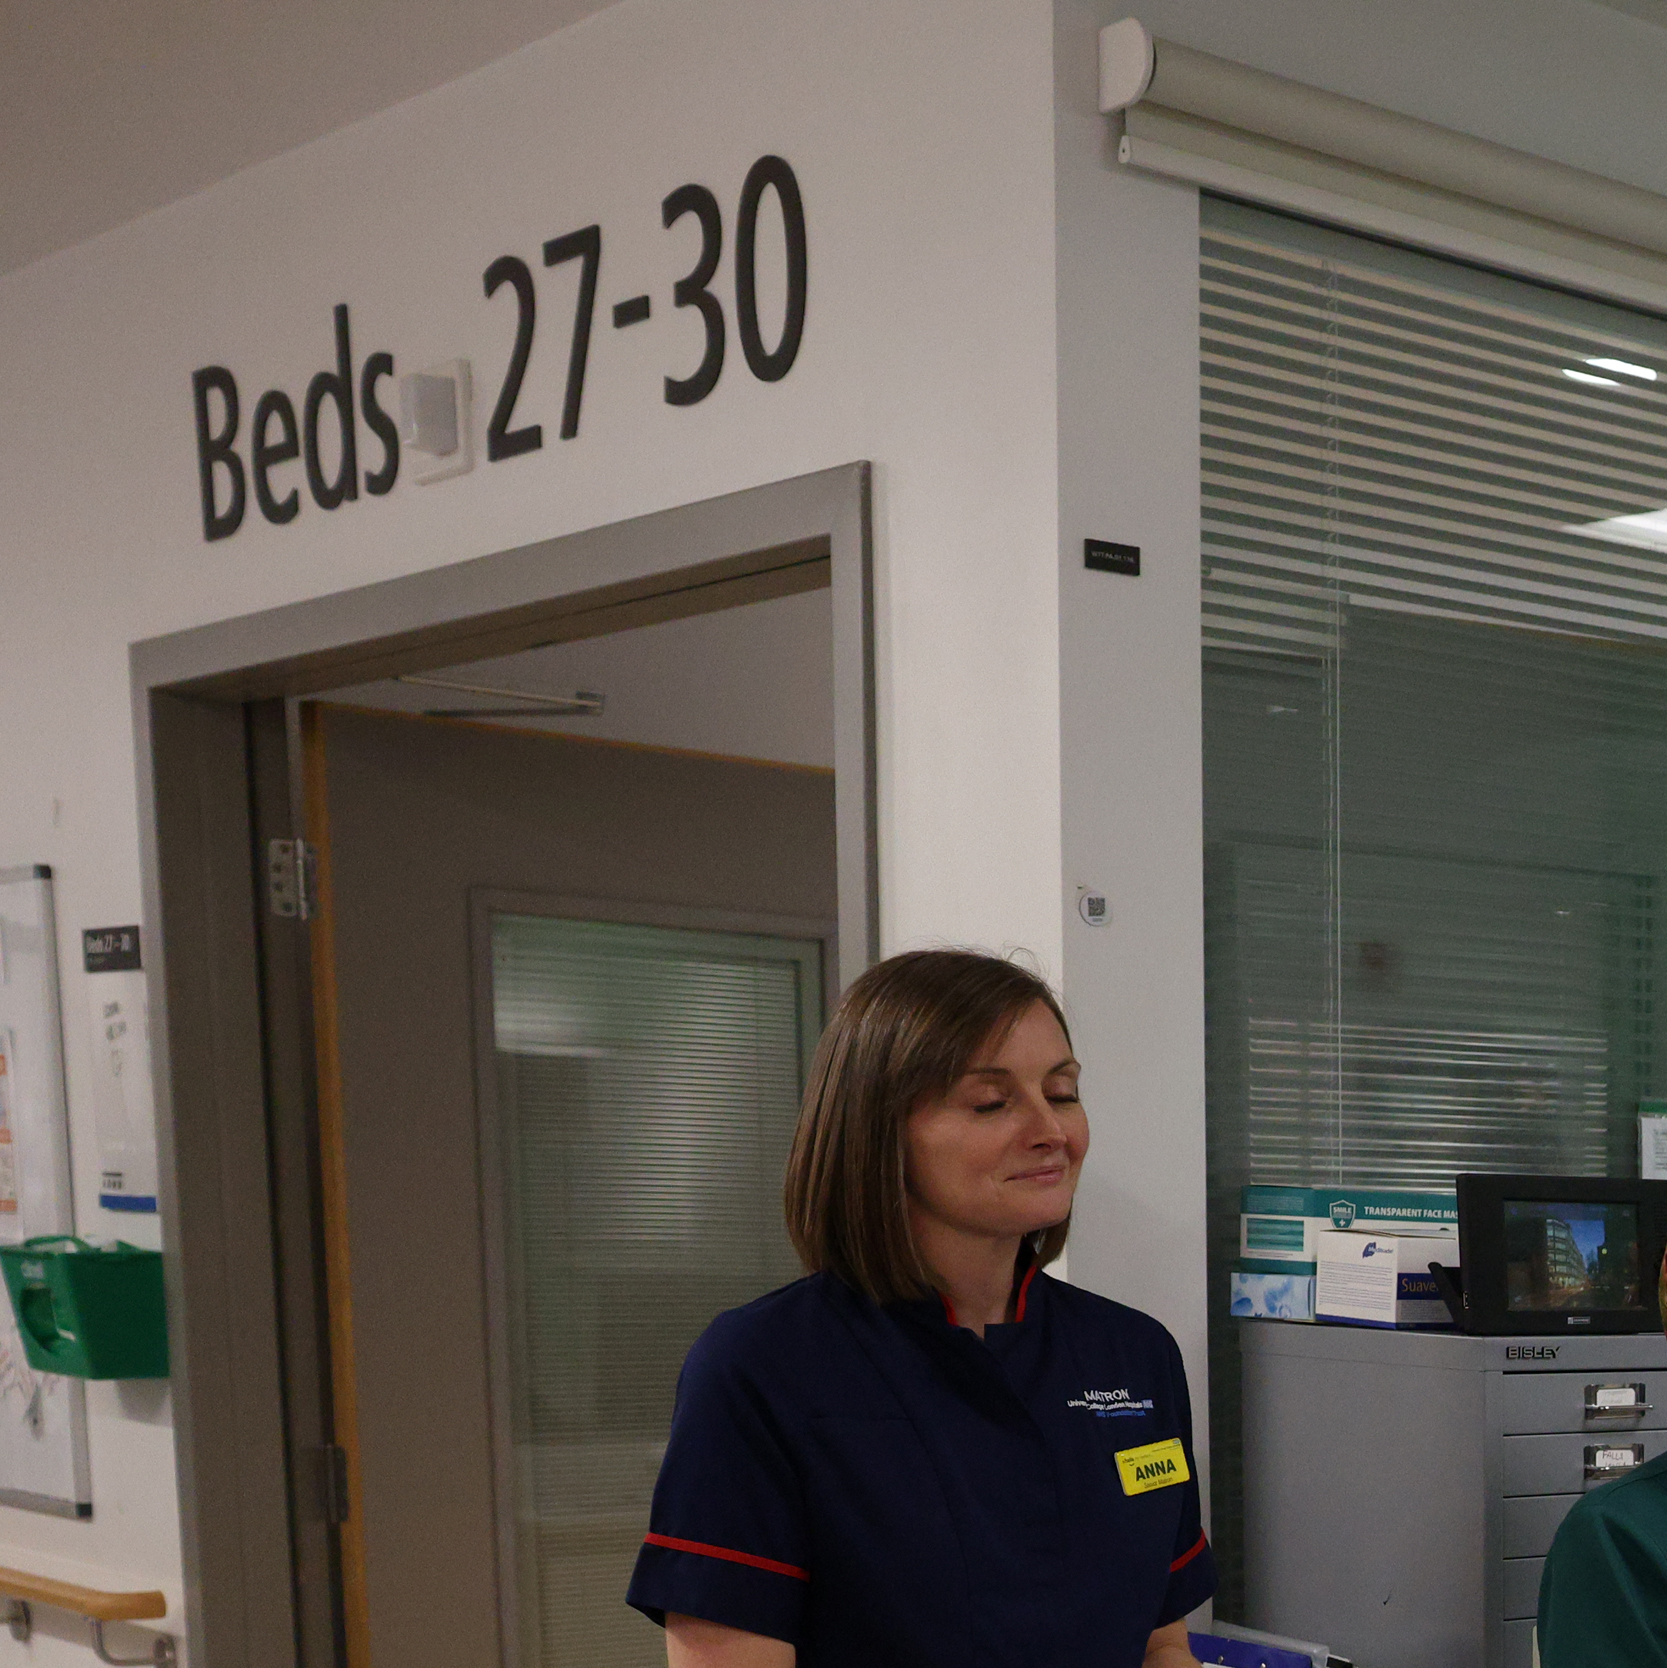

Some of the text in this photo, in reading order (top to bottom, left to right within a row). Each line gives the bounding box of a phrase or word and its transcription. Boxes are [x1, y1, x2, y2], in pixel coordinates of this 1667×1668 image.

[192, 154, 808, 543] Beds 27-30
[1333, 1206, 1352, 1214] SMILE
[1364, 1206, 1458, 1220] TRANSPARENT FACE MAS
[1401, 1277, 1438, 1292] Suave
[1506, 1346, 1560, 1360] BISLEY
[1084, 1389, 1130, 1402] MATRON
[1136, 1459, 1177, 1481] ANNA
